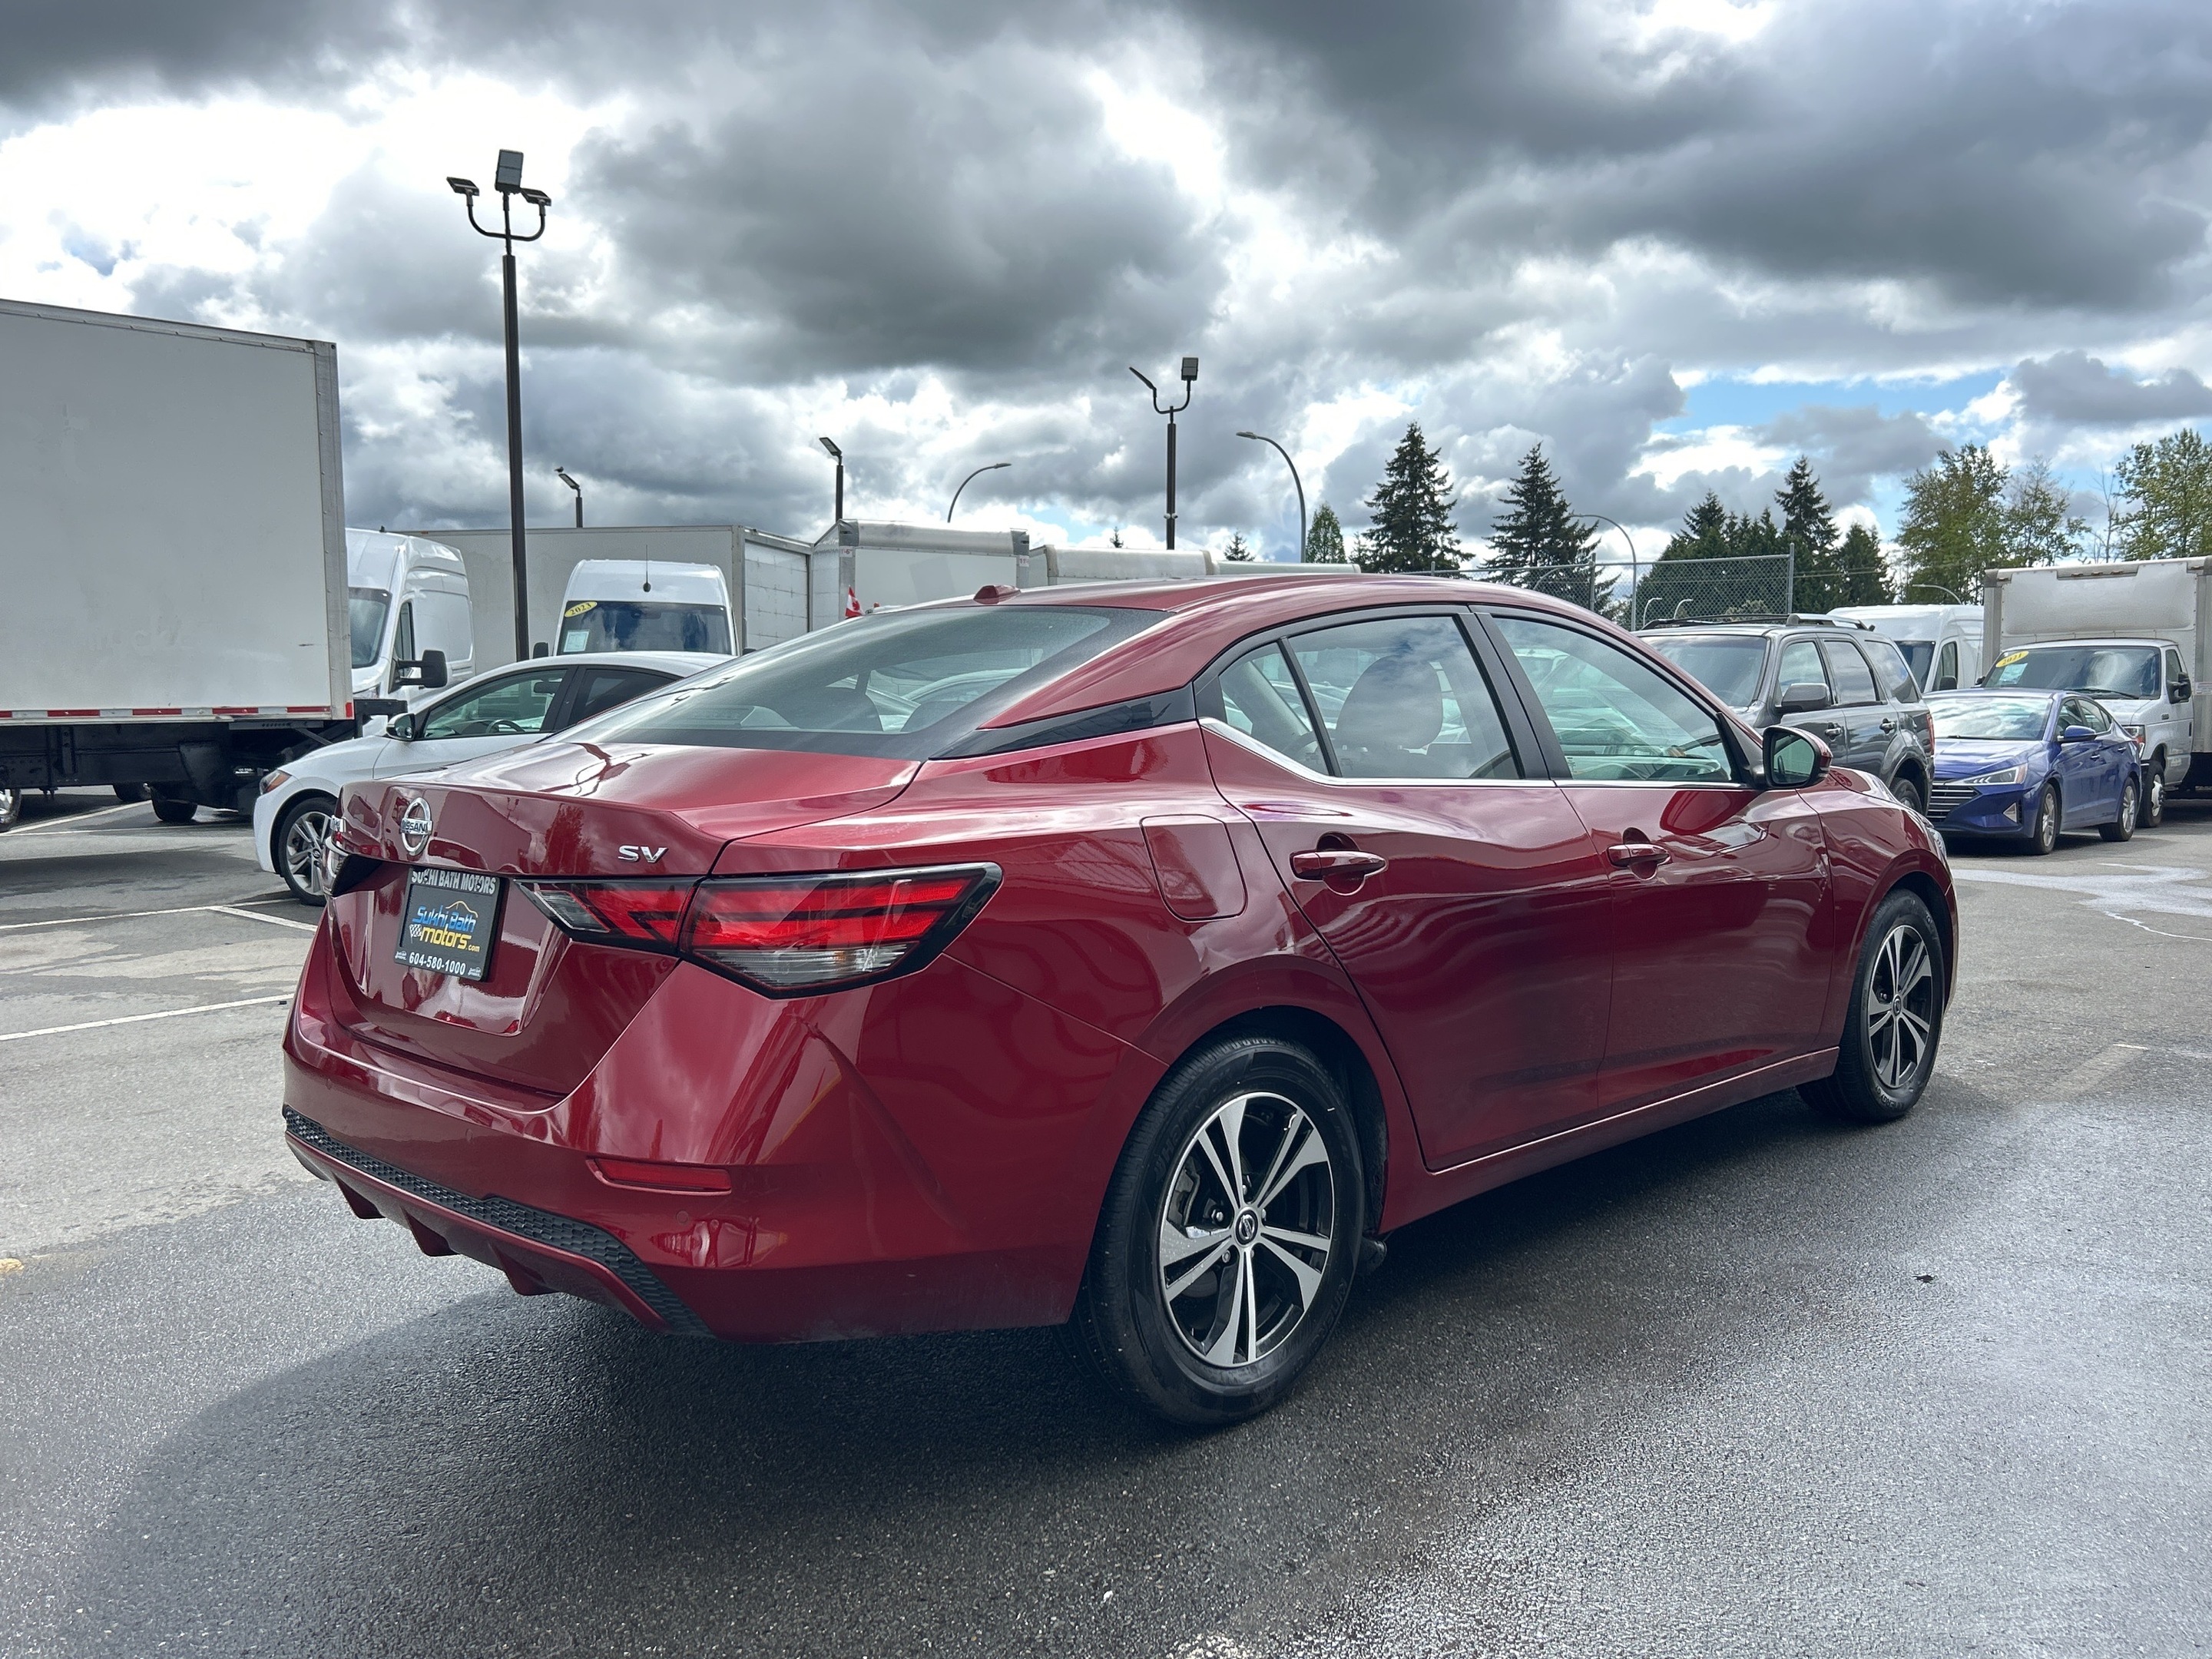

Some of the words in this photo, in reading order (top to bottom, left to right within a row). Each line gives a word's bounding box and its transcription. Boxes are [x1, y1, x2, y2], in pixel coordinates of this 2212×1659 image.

[570, 602, 592, 615] 2023
[2002, 653, 2022, 665] 2021
[618, 845, 667, 863] SV
[411, 869, 439, 886] SUKHI
[439, 870, 461, 889] BATH
[460, 873, 497, 894] MOTORS
[412, 905, 449, 927] Sukhi
[448, 911, 476, 932] Bath
[409, 952, 466, 975] 604-580-1000
